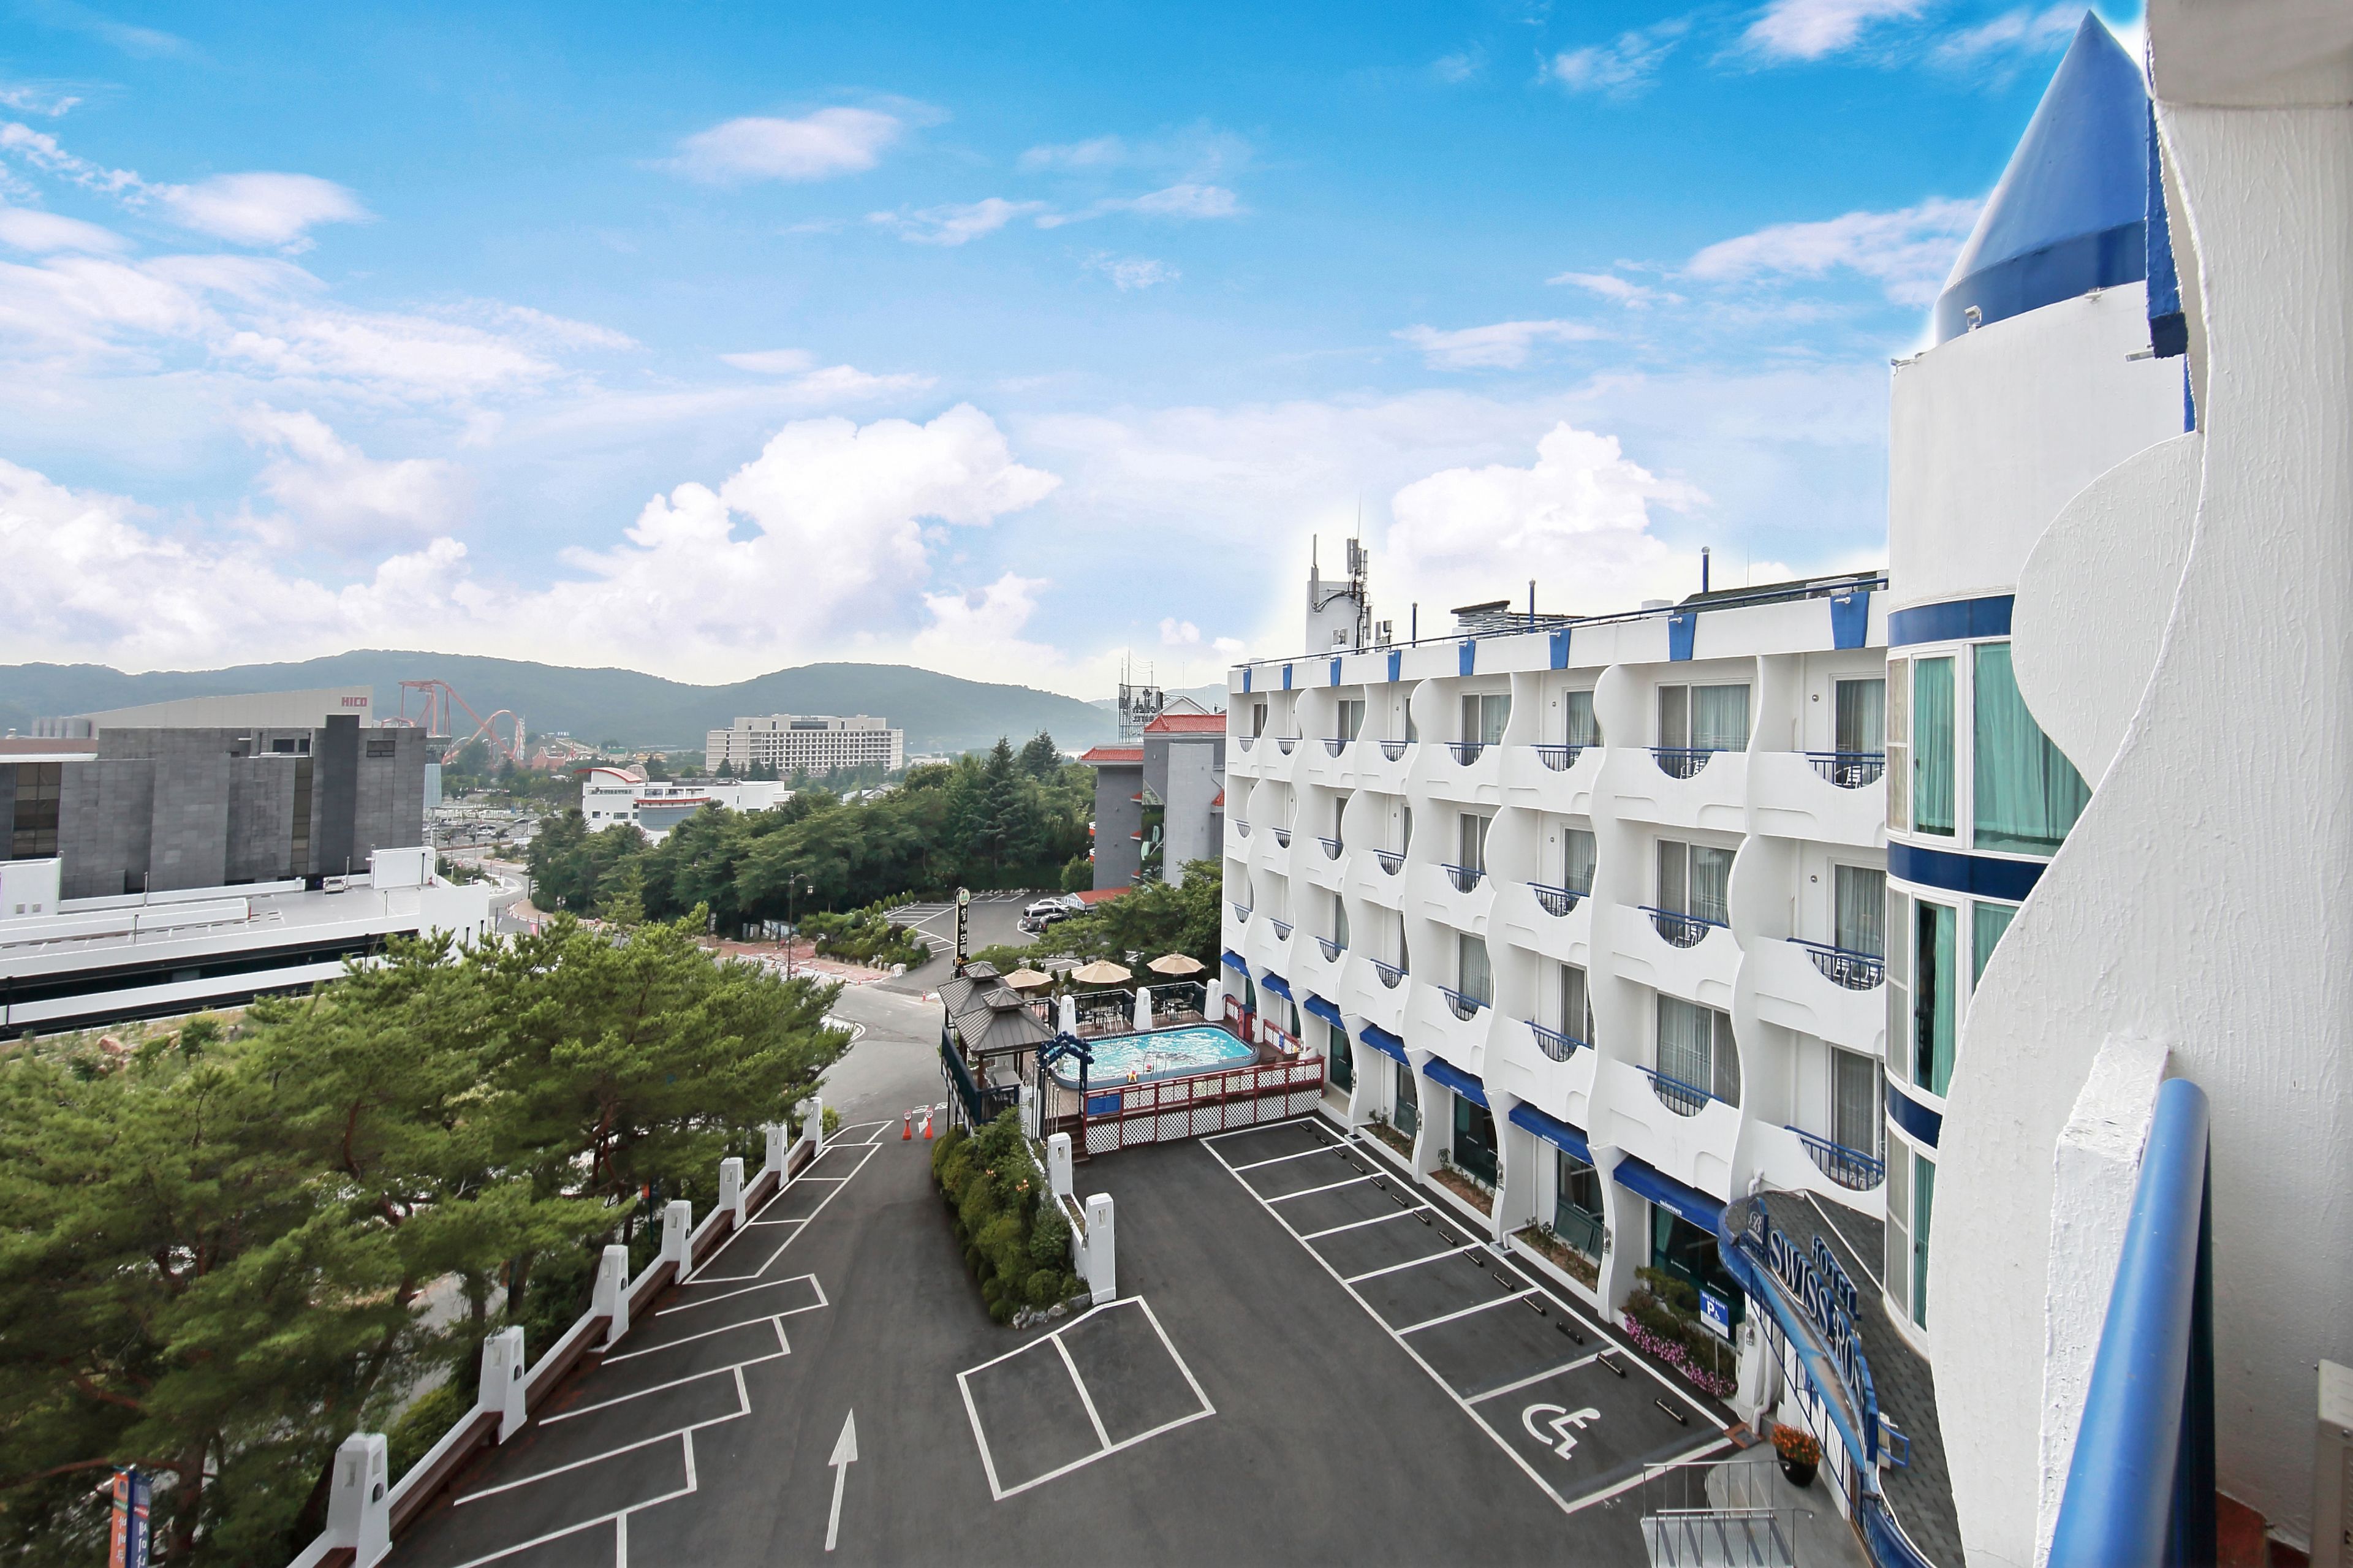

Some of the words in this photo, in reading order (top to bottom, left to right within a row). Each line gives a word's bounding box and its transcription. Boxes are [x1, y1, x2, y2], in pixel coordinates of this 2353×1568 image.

[1707, 1300, 1715, 1316] P
[1769, 1229, 1832, 1336] SWISS
[1811, 1234, 1859, 1319] HOTEL
